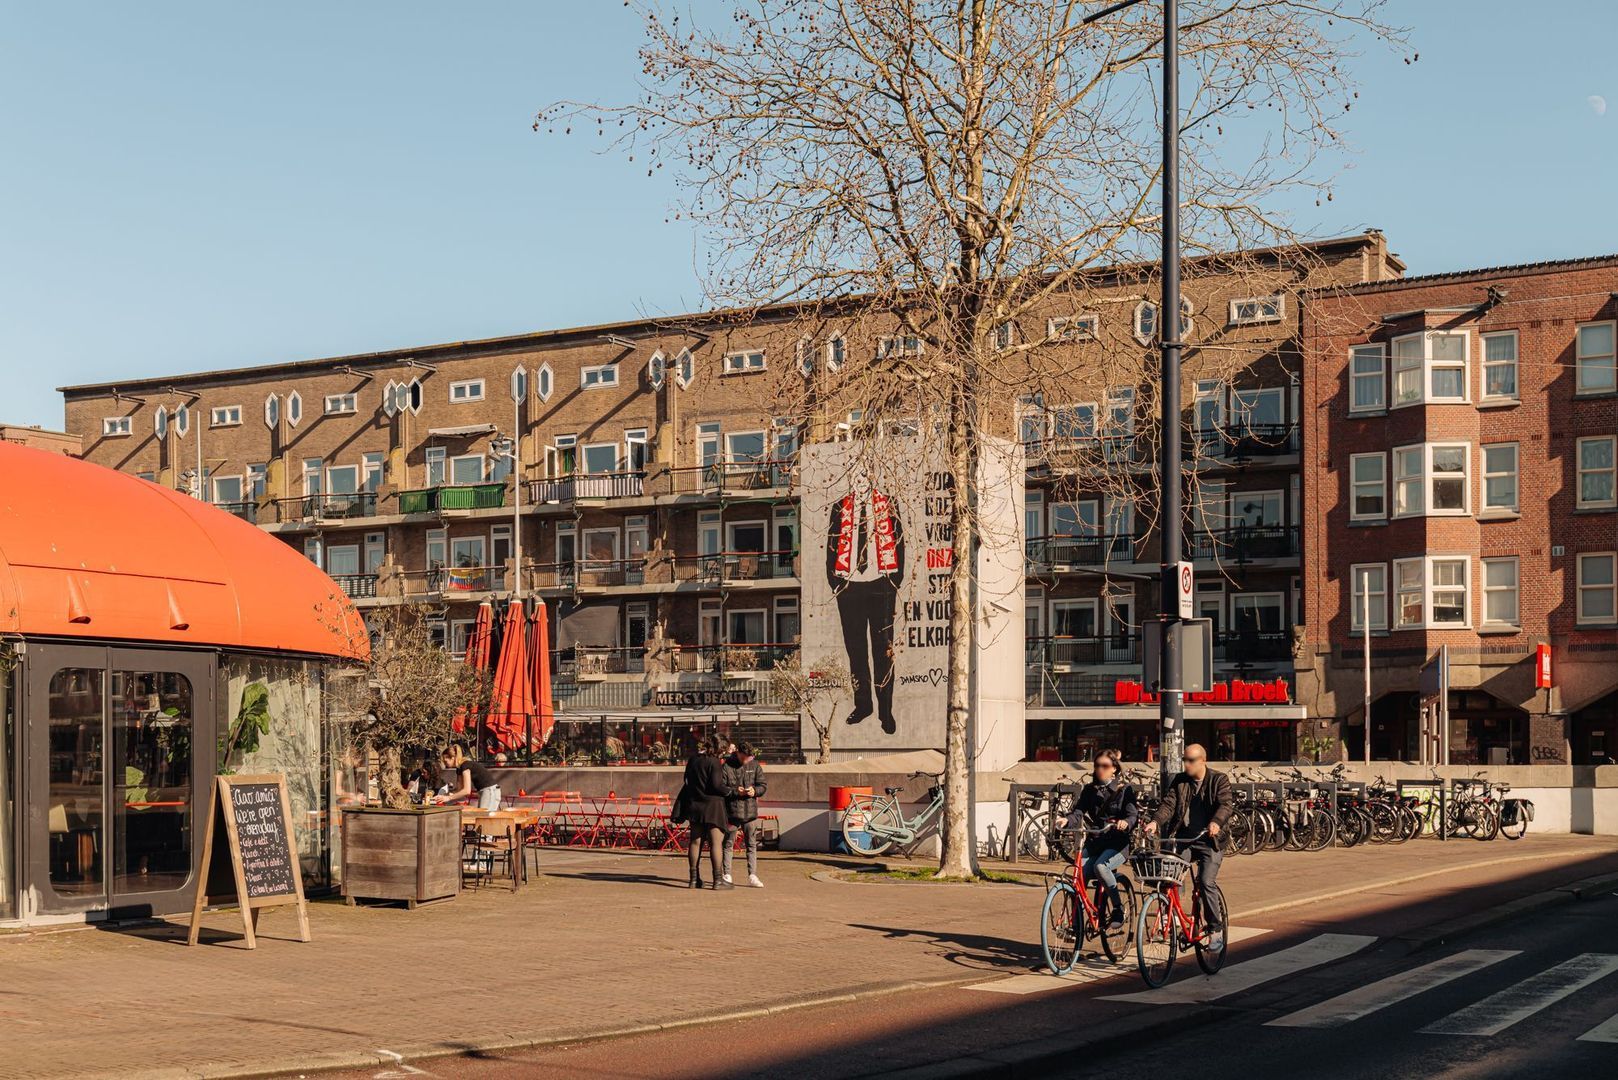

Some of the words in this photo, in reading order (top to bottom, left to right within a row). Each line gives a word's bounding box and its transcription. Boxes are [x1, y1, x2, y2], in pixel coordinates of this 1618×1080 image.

[925, 471, 954, 490] ZOR
[927, 549, 952, 568] ONZ
[928, 574, 952, 594] STA
[926, 600, 951, 621] VOO
[908, 627, 950, 647] ELKAA
[656, 692, 701, 705] MERCY
[704, 691, 755, 704] BEAUTY
[1232, 677, 1289, 702] Broek
[234, 788, 253, 805] Ciao
[255, 788, 275, 803] amici
[235, 809, 257, 824] We're
